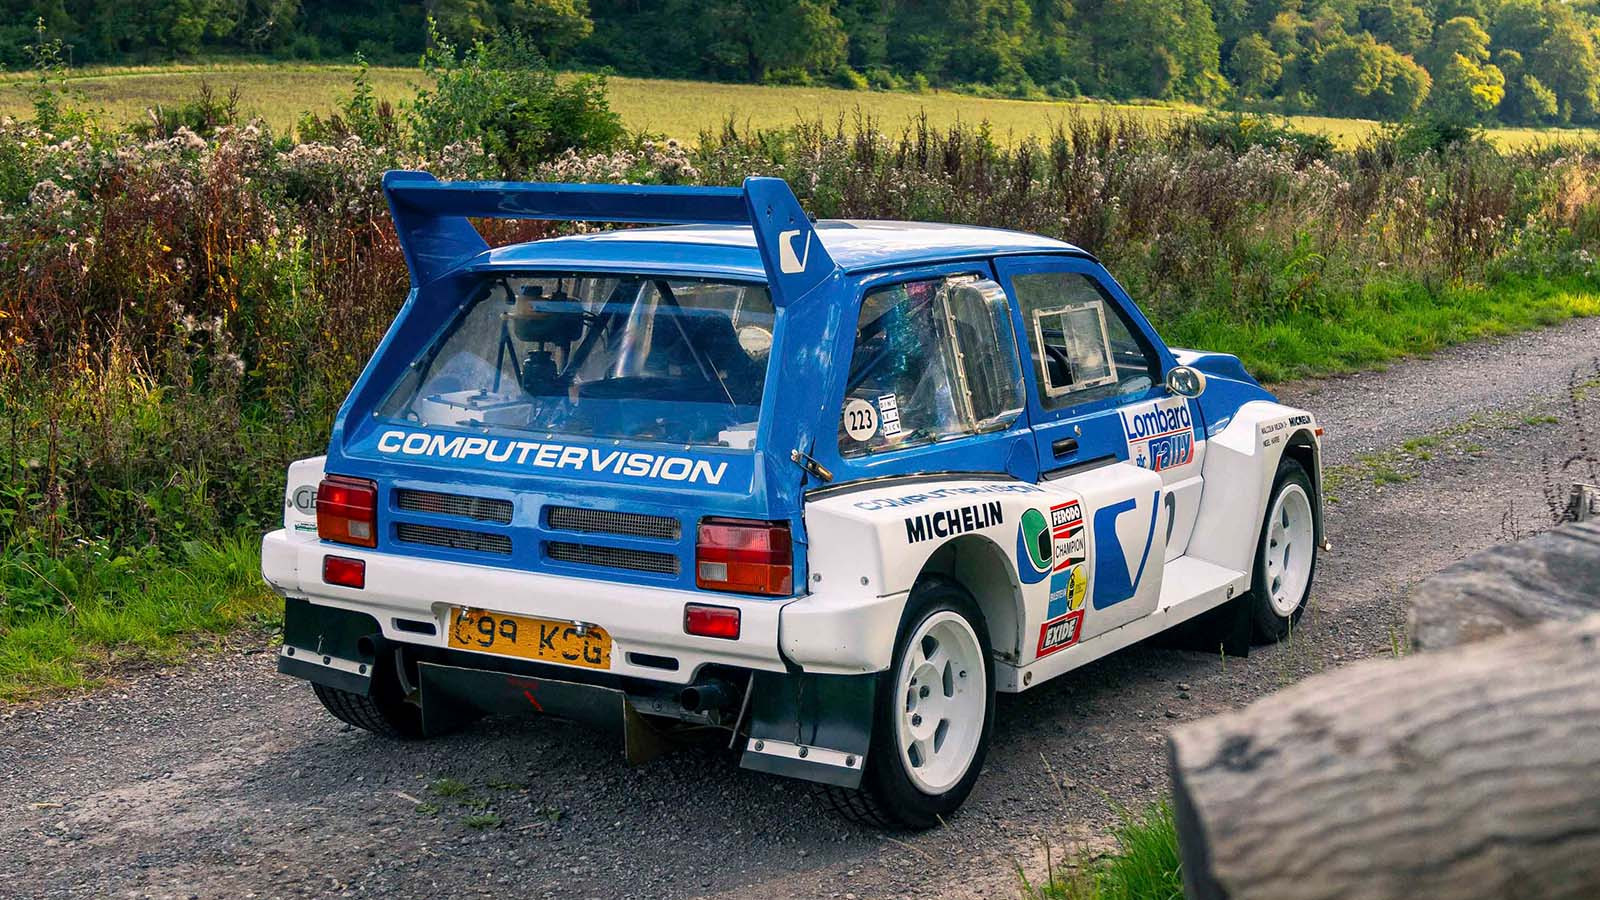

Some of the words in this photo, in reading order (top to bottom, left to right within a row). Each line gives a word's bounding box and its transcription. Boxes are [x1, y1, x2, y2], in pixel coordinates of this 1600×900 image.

[849, 409, 873, 431] 223
[1121, 403, 1191, 440] Lombard
[378, 430, 728, 484] COMPUTERVISION
[905, 500, 1003, 544] MICHELIN
[1052, 505, 1081, 527] FERODO
[1055, 538, 1084, 558] CHAMPION
[1045, 619, 1076, 647] EXIDE
